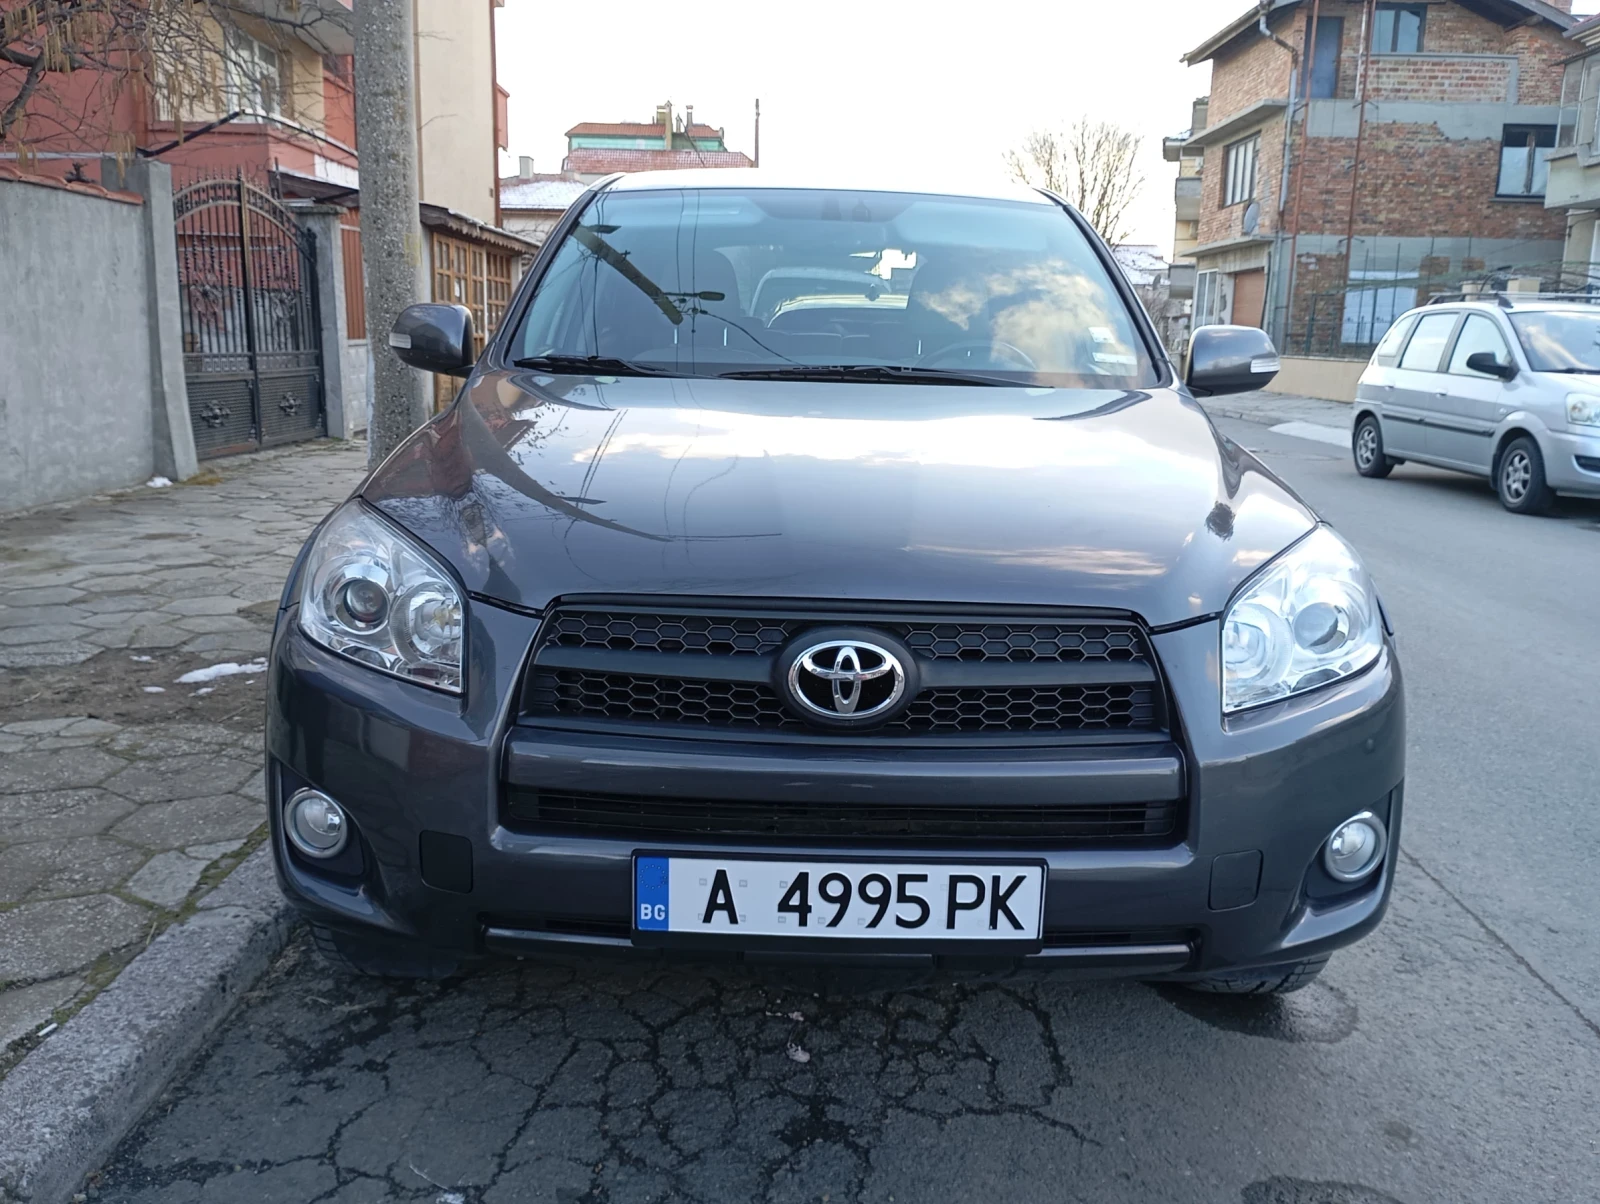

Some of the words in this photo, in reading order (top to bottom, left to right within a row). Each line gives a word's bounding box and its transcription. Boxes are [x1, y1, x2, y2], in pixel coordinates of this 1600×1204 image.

[640, 903, 666, 921] BG
[702, 869, 739, 924] A
[777, 871, 930, 929] 4995
[945, 874, 1027, 931] PK
